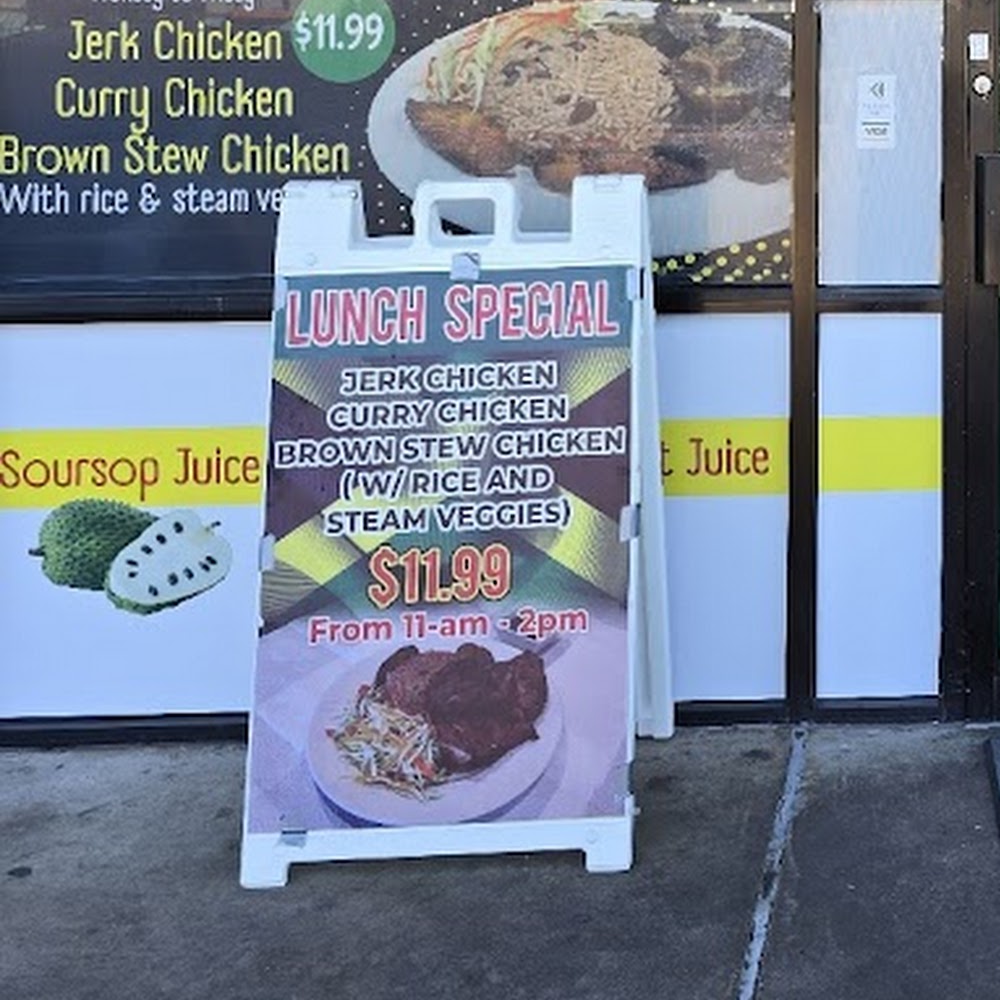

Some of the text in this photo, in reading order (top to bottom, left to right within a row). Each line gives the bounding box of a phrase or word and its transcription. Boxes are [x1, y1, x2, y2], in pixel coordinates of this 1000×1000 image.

[67, 19, 284, 62] Jerk Chicken
[294, 9, 385, 53] $11.99
[54, 76, 294, 134] Curry Chicken
[0, 132, 350, 176] Brown Stew Chicken
[0, 182, 70, 215] With
[79, 182, 130, 215] rice
[138, 182, 161, 214] &
[172, 182, 251, 214] steam
[285, 279, 620, 348] LUNCH SPECIAL
[341, 360, 558, 395] JERK CHICKEN
[327, 396, 569, 431] CURRY CHICKEN
[274, 426, 627, 468] BROWN STEW CHICKEN
[686, 437, 771, 477] Juice
[0, 446, 261, 502] Soursop Juice
[411, 470, 479, 497] RICE
[486, 466, 554, 493] AND
[325, 498, 573, 536] STEAM VEGGIES)
[367, 543, 512, 610] $11.99
[309, 617, 394, 645] From
[402, 610, 490, 641] 11-am
[518, 607, 589, 640] 2pm
